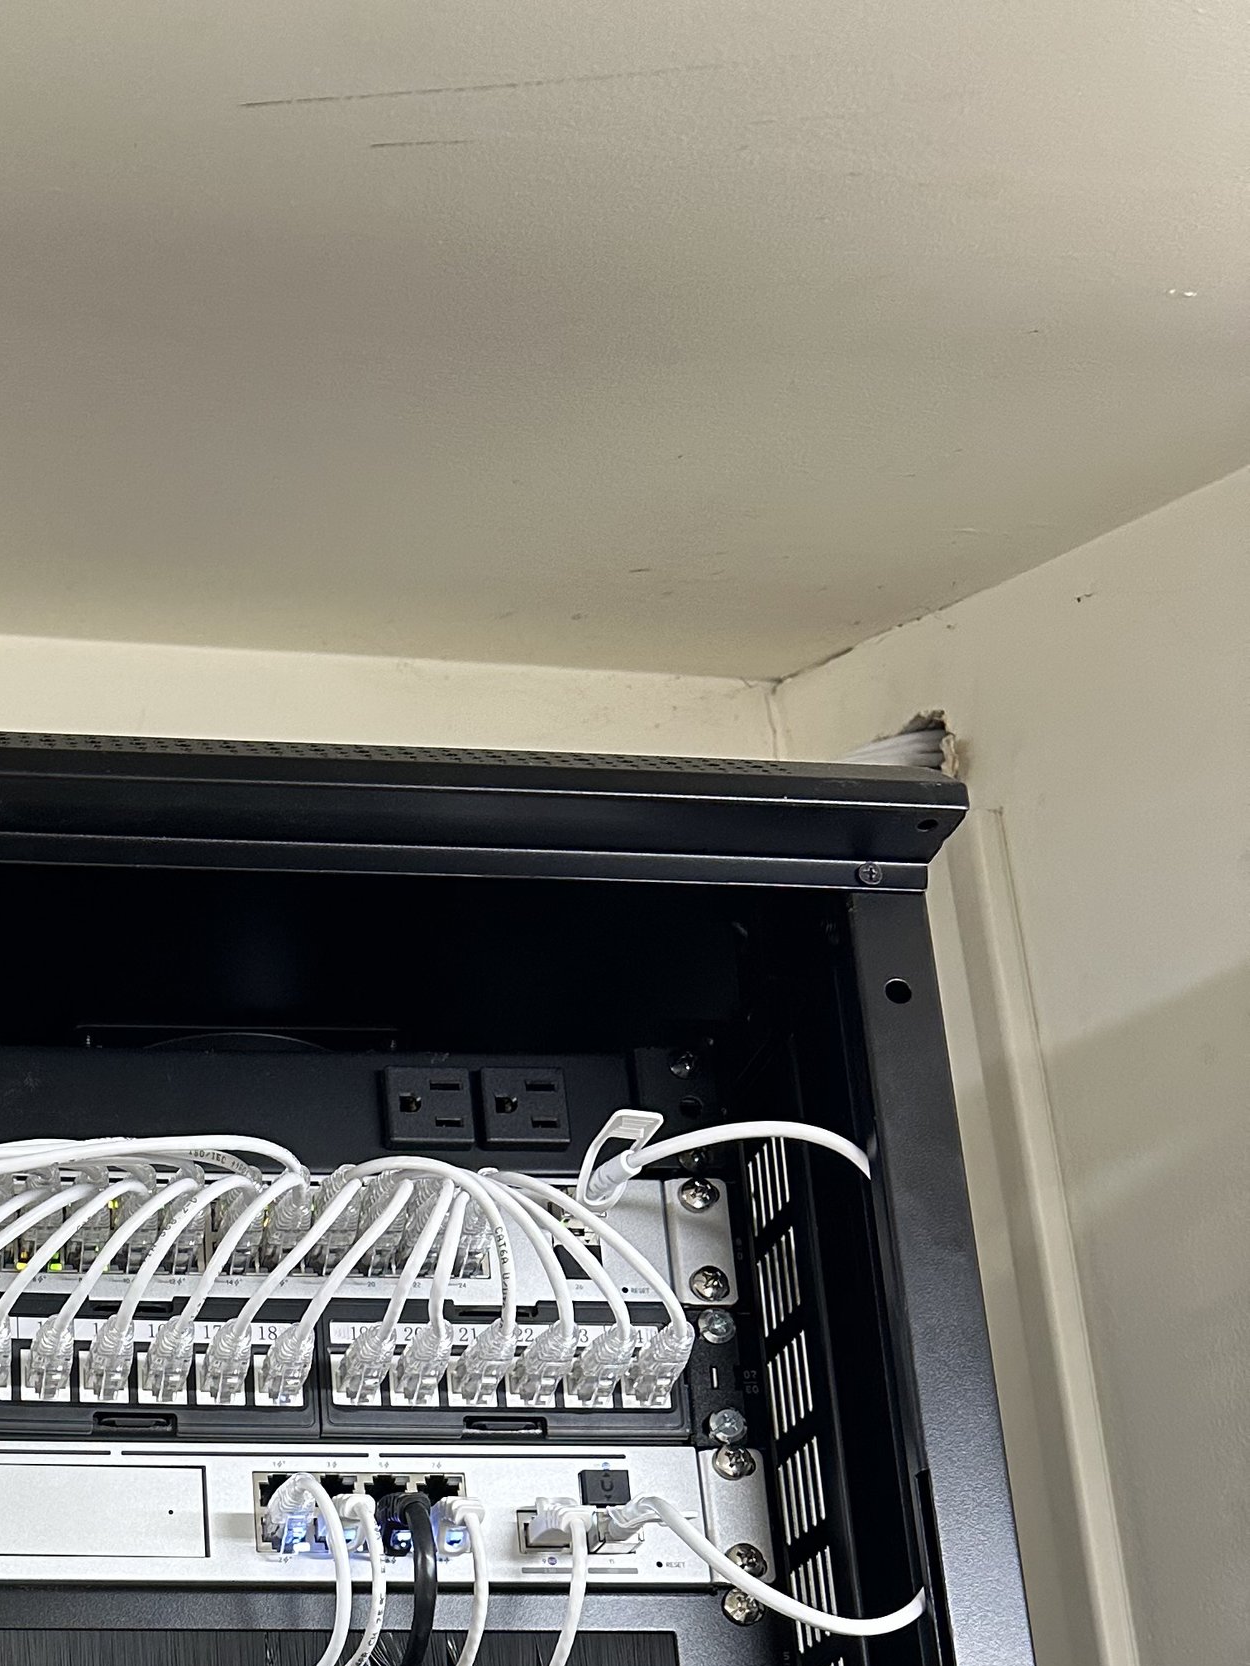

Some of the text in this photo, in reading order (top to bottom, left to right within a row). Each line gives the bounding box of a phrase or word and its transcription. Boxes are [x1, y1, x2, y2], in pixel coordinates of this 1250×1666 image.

[204, 1324, 222, 1339] 17
[259, 1325, 278, 1340] 18
[458, 1328, 478, 1343] 21
